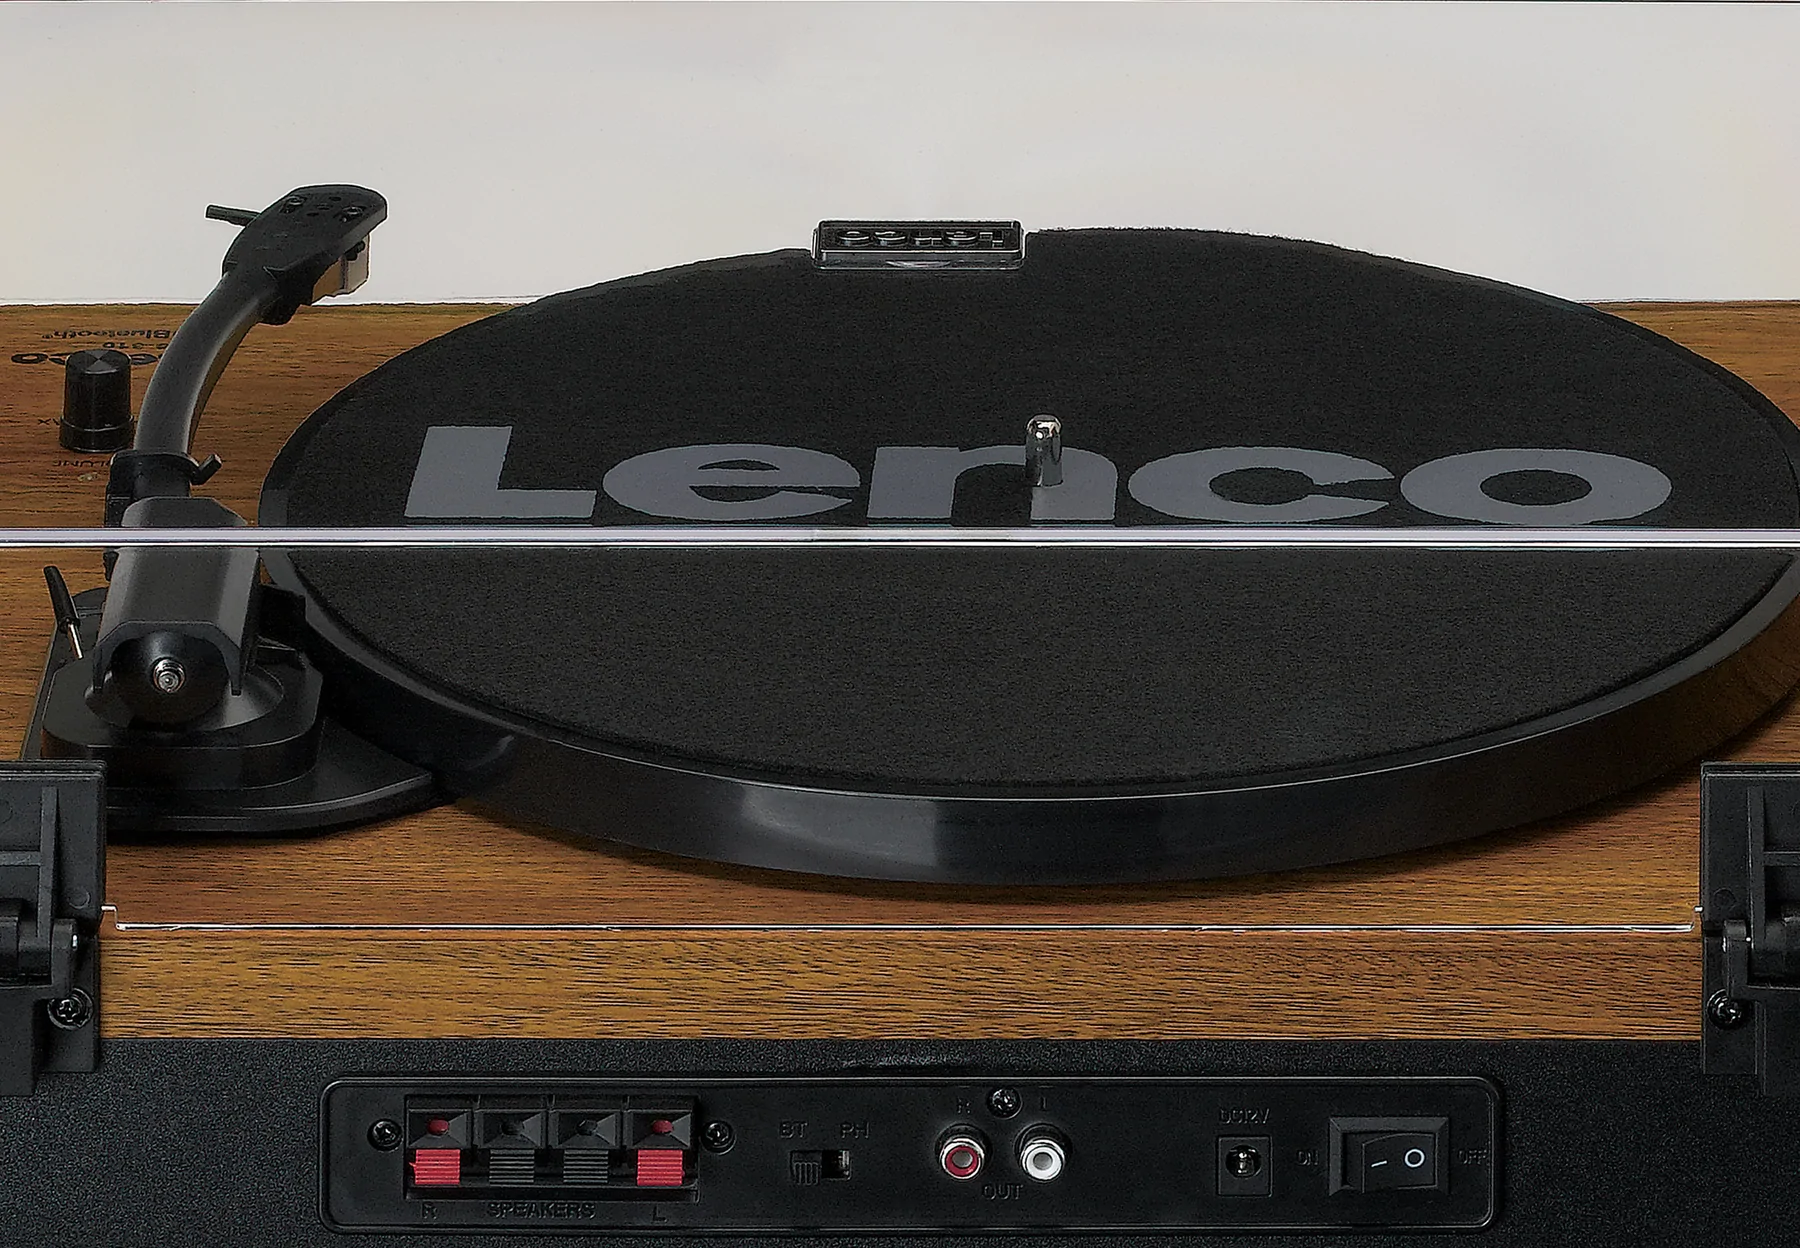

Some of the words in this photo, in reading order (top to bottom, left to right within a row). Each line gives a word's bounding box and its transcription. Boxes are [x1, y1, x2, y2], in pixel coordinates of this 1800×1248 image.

[404, 424, 1673, 526] Lenco
[780, 1120, 809, 1139] BT
[840, 1120, 871, 1140] PH
[982, 1183, 1024, 1201] OUT
[421, 1202, 438, 1220] R
[486, 1202, 597, 1220] SPEAKERS
[651, 1206, 668, 1223] L
